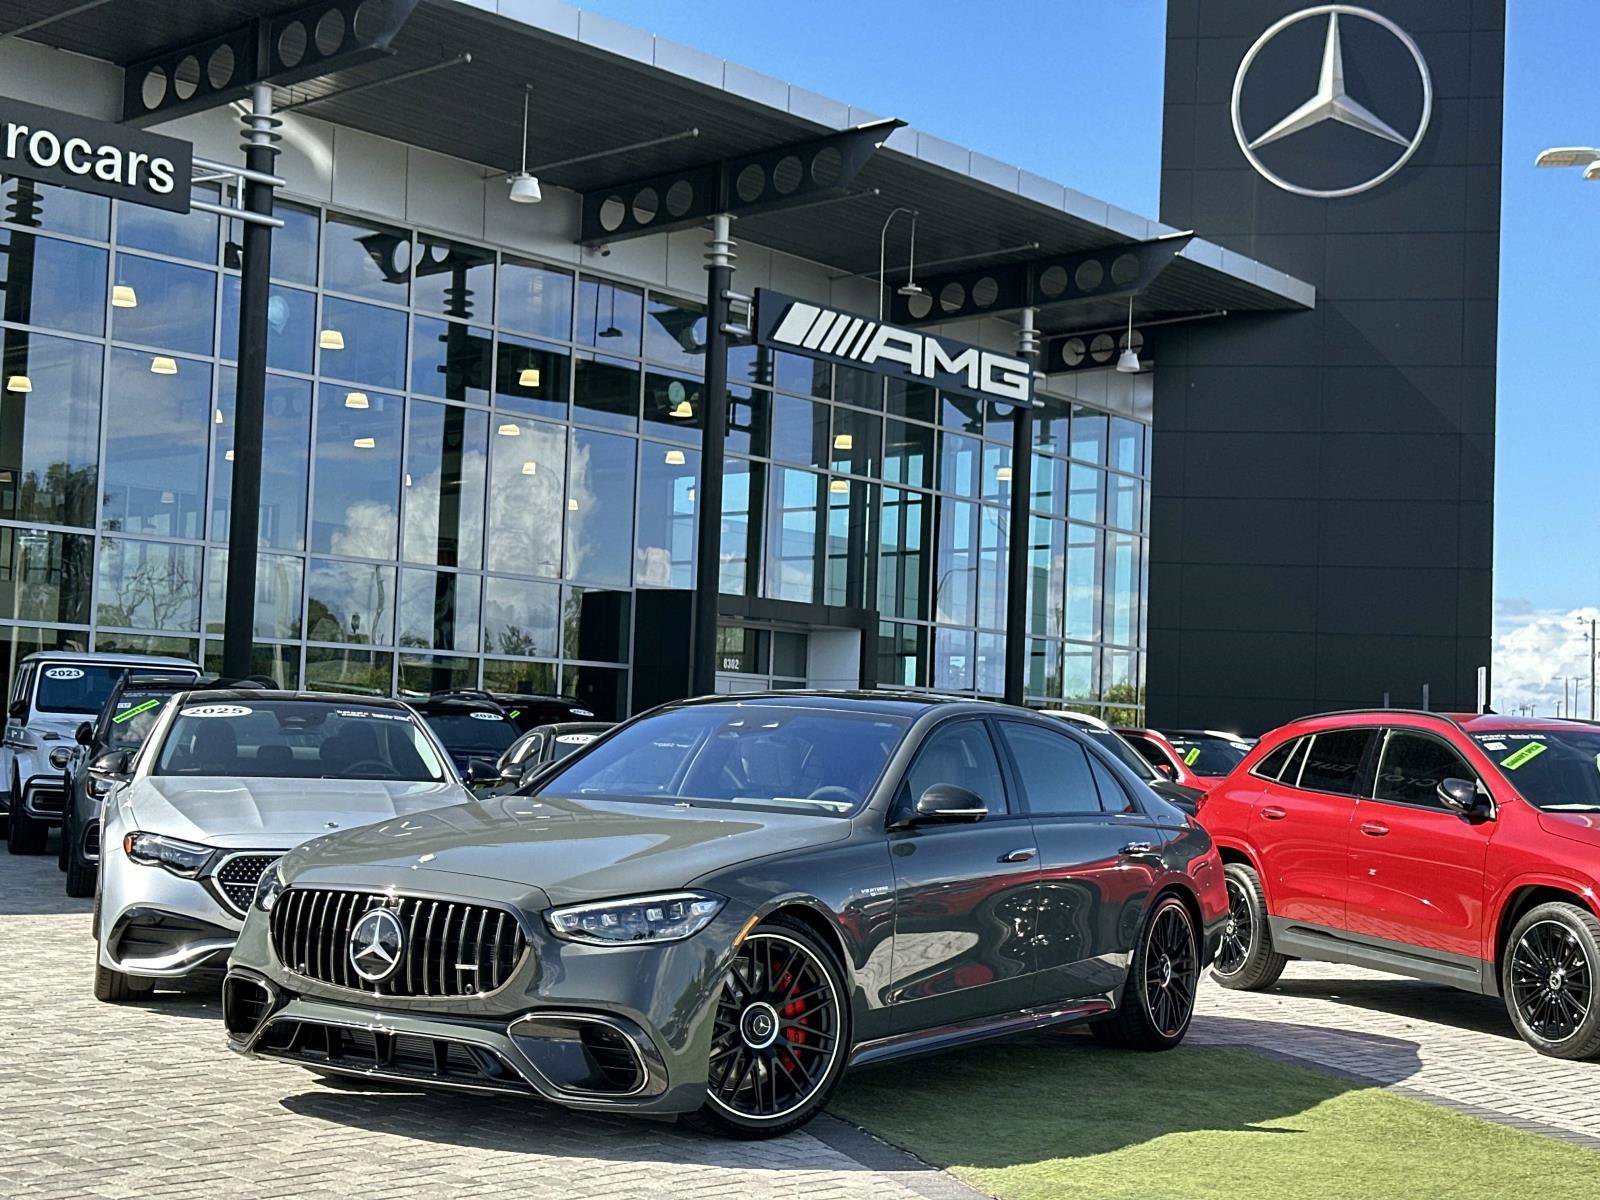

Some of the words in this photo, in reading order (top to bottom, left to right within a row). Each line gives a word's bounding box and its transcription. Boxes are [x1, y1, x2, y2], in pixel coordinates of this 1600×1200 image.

[7, 122, 175, 194] rocars
[861, 324, 1030, 401] AMG
[188, 707, 244, 715] 2025
